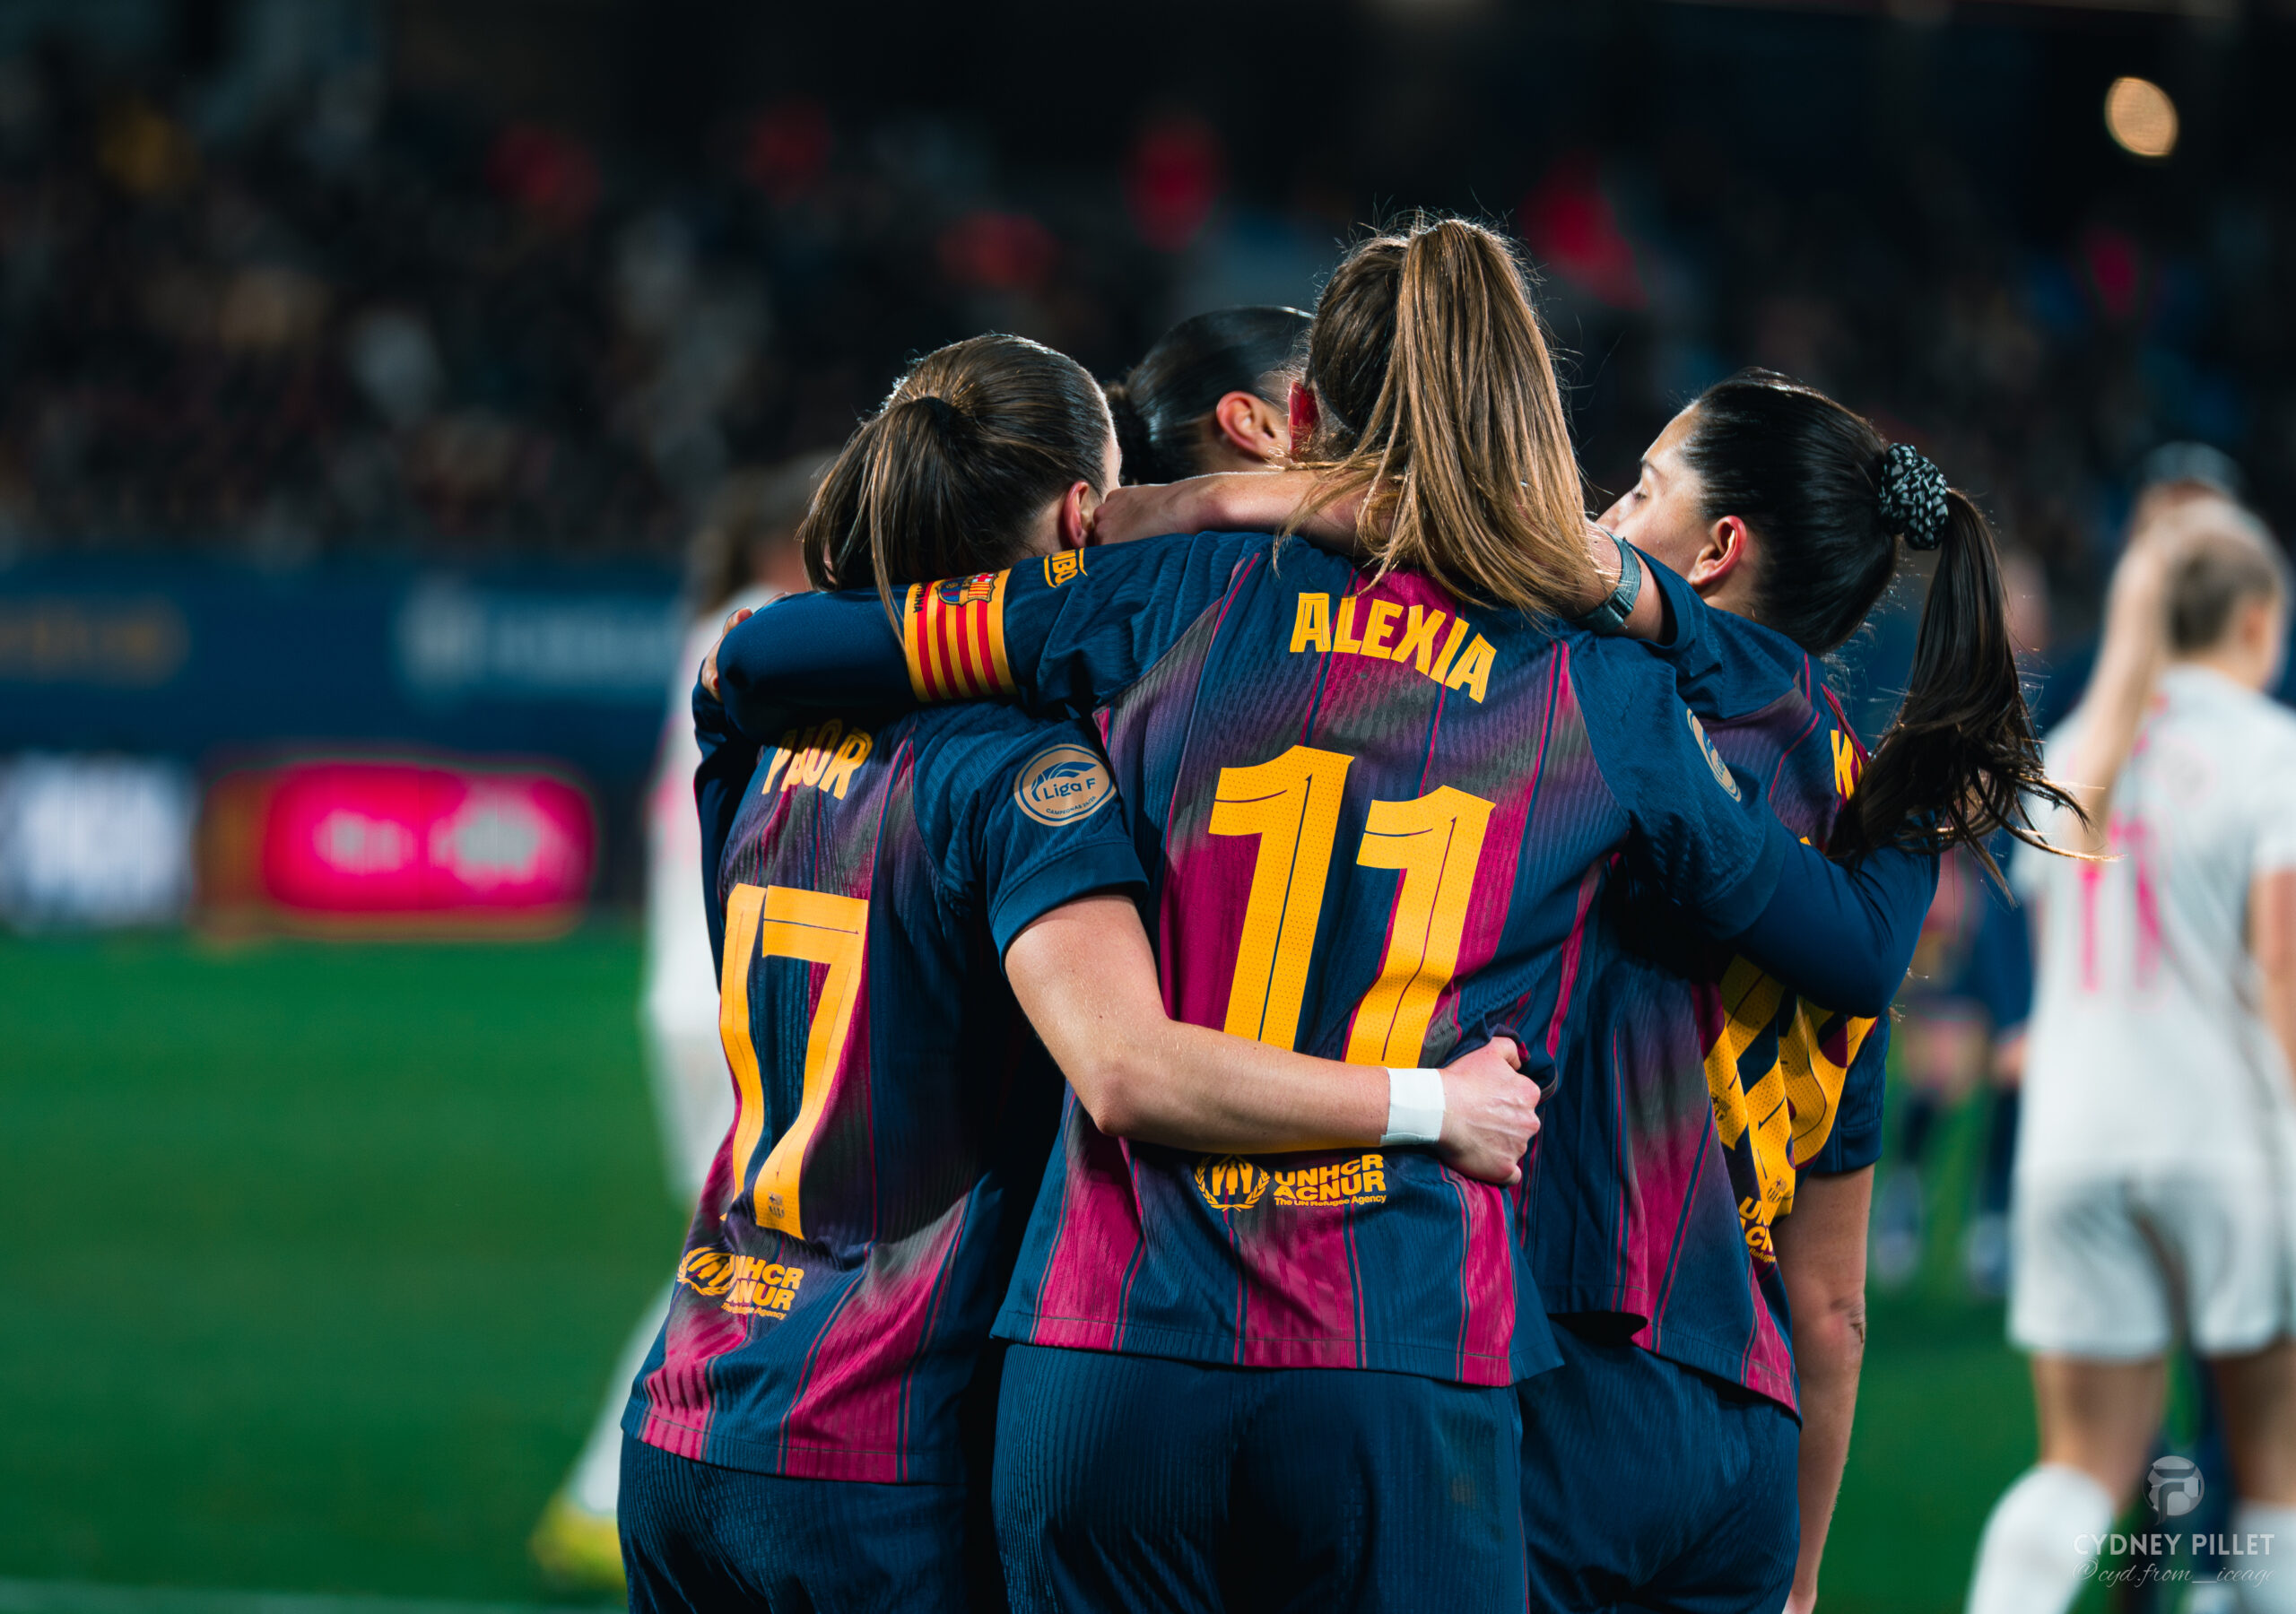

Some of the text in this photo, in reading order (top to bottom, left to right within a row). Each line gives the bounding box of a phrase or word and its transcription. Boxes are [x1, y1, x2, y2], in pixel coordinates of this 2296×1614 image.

[1290, 592, 1497, 704] ALEXIA
[1043, 777, 1096, 800] Liga F
[1208, 744, 1497, 1069] 11
[719, 882, 869, 1240] 17
[1273, 1169, 1387, 1202] ACNUR
[1274, 1154, 1384, 1186] UNHCR
[1274, 1197, 1292, 1206] The
[1351, 1193, 1387, 1205] Agency
